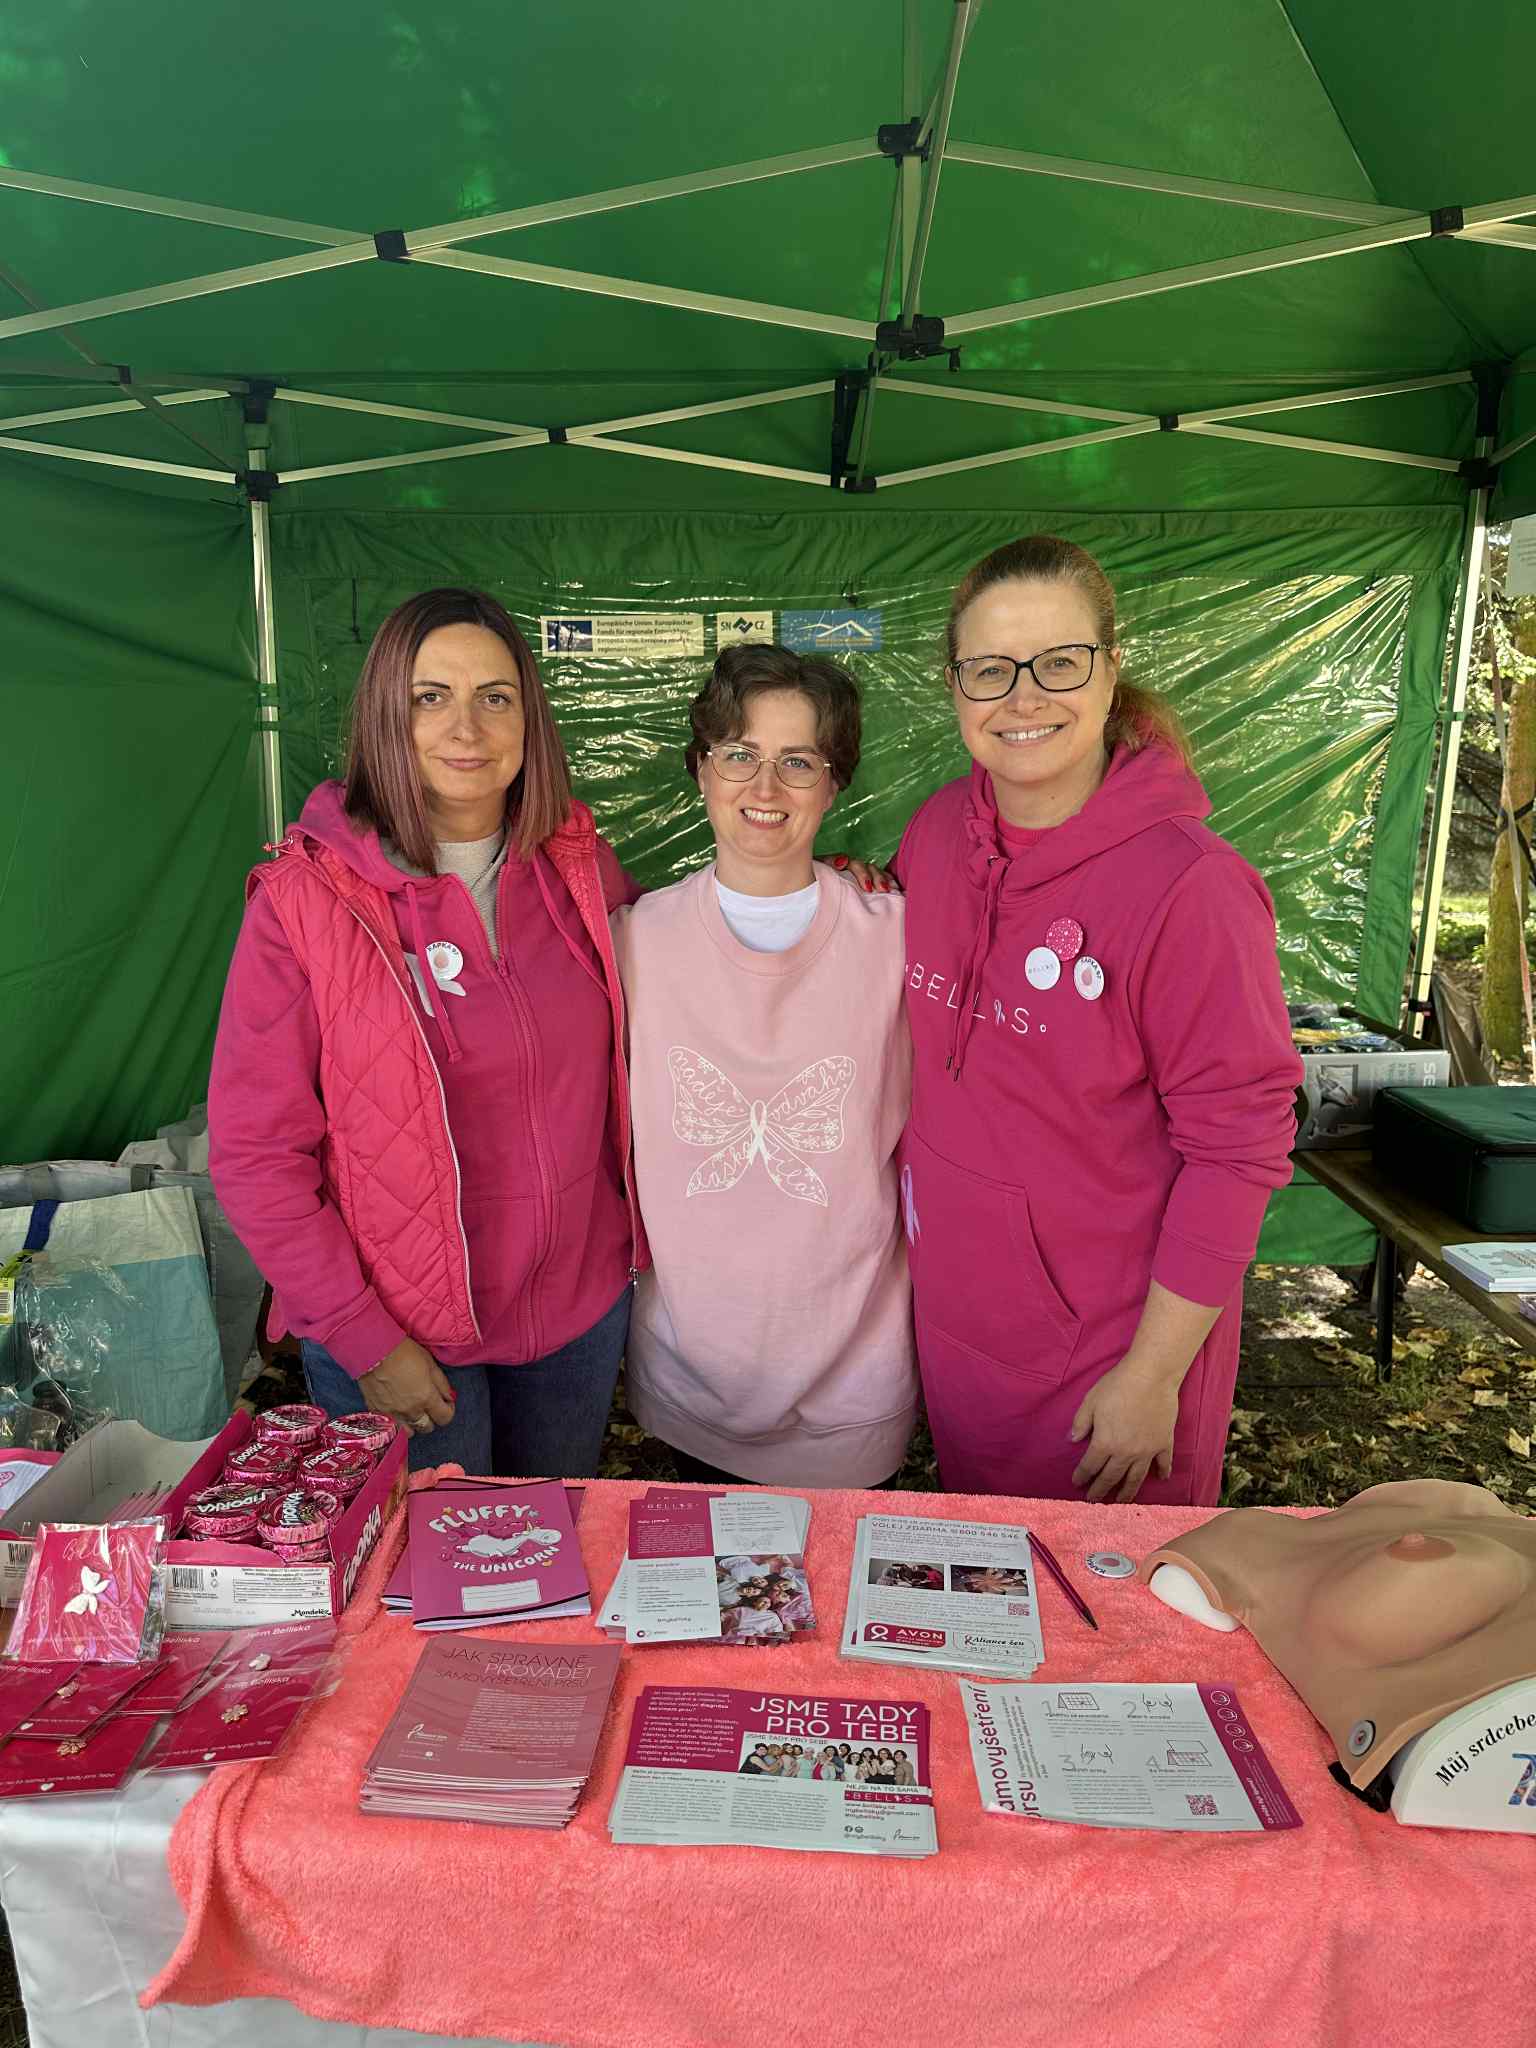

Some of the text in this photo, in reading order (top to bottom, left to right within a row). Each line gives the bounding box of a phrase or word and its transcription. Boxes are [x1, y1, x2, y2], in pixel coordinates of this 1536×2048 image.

[720, 620, 765, 632] SN CZ
[428, 1504, 531, 1534] FLUFFY
[871, 1522, 904, 1533] VOLEJ
[905, 1525, 948, 1535] ZDARMA
[453, 1561, 477, 1572] THE
[480, 1545, 560, 1574] UNICORN
[895, 1628, 944, 1640] AVON
[972, 1636, 1008, 1646] Aliance
[443, 1648, 486, 1664] JAK
[750, 1697, 918, 1723] JSME TADY
[766, 1716, 918, 1743] PRO TEBE
[1434, 1751, 1469, 1787] Můj
[846, 1783, 868, 1792] NEJSI
